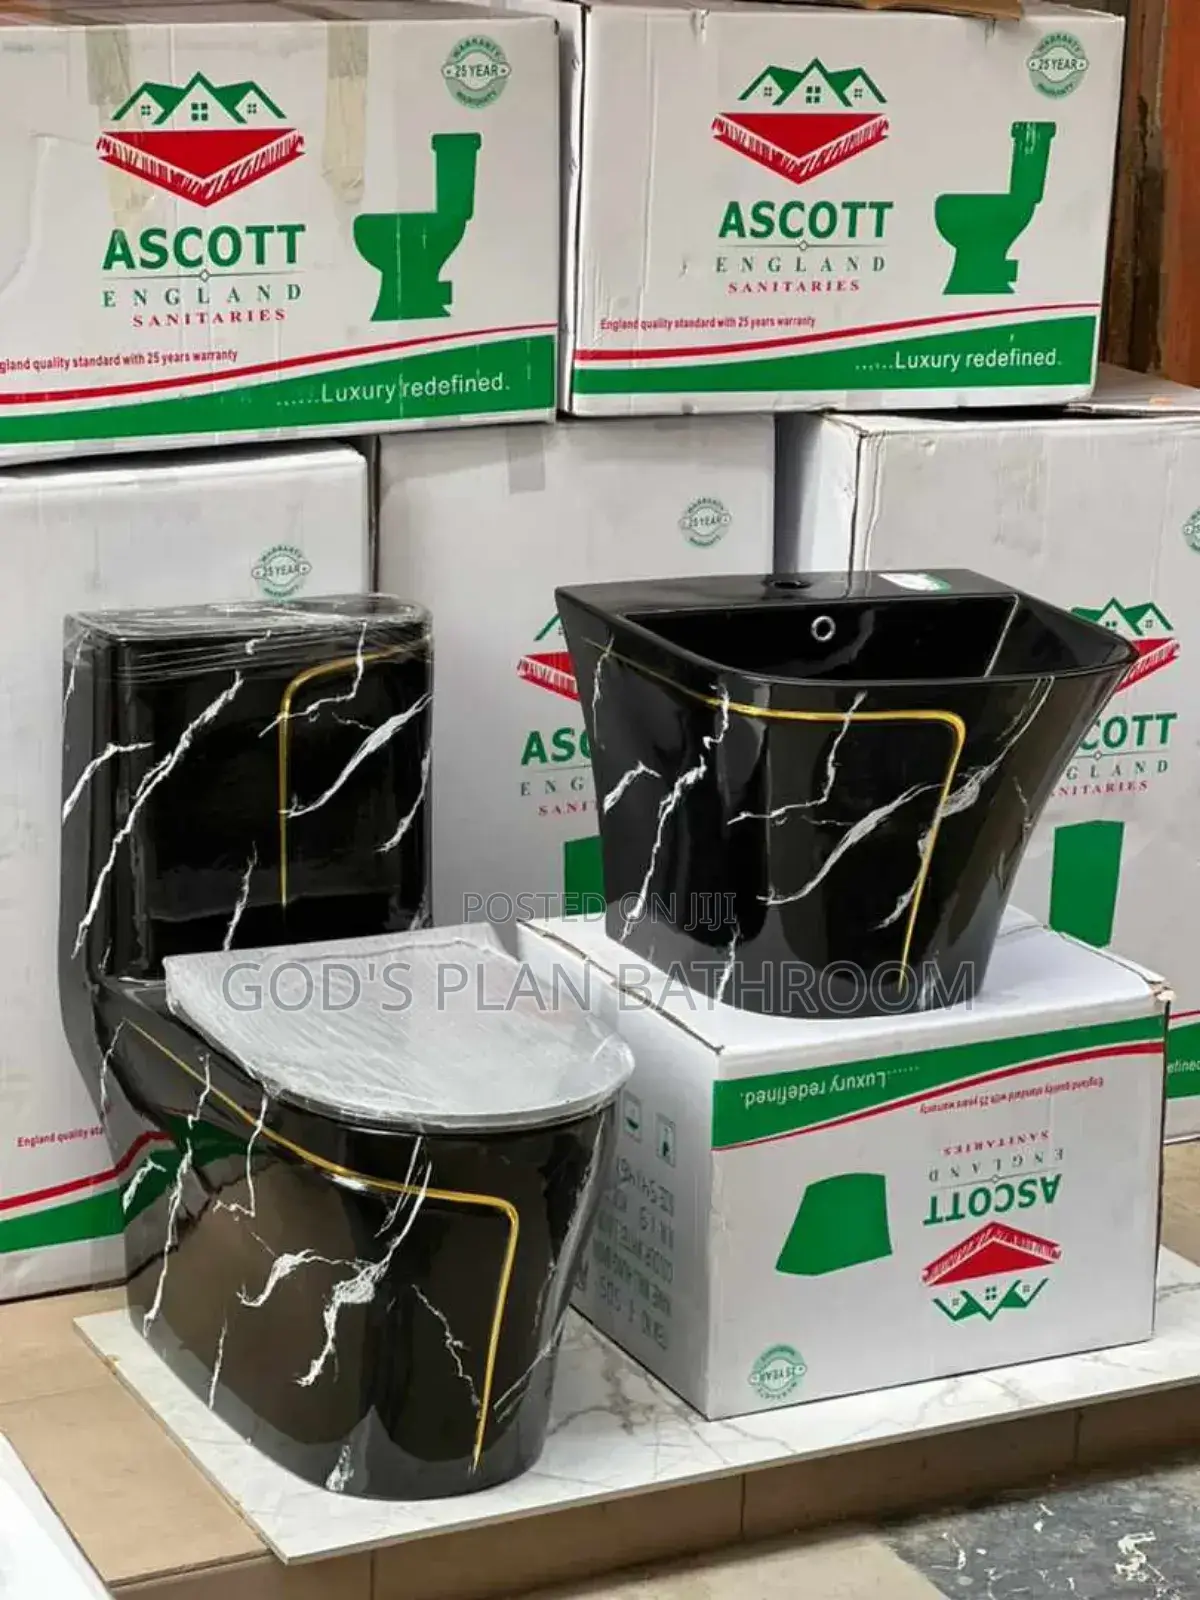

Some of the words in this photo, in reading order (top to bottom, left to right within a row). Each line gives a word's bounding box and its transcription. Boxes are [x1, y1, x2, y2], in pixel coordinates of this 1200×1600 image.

[455, 65, 466, 77] 25
[468, 64, 499, 77] YEAR
[1039, 59, 1050, 70] 25
[1051, 58, 1077, 70] YEAR
[718, 200, 894, 239] ASCOTT
[102, 224, 305, 270] ASCOTT
[716, 256, 885, 272] ENGLAND
[103, 284, 301, 308] ENGLAND
[728, 279, 860, 294] SANITARIES
[132, 309, 286, 327] SANITARIES
[600, 318, 639, 332] England
[641, 318, 672, 331] quality
[675, 316, 715, 329] standard
[718, 316, 736, 328] with
[738, 315, 749, 328] 25
[751, 316, 775, 330] years
[778, 315, 815, 329] warranty
[0, 355, 31, 374] gland
[33, 355, 70, 373] quality
[73, 353, 120, 369] standard
[122, 354, 145, 366] with
[147, 351, 160, 364] 25
[162, 350, 190, 365] years
[193, 349, 237, 363] warranty
[966, 347, 1062, 368] redefined.
[402, 371, 511, 398] redefined.
[1066, 759, 1168, 781] GLAND
[1056, 780, 1148, 798] NITARIES
[740, 1080, 826, 1111] redefined.
[17, 1132, 56, 1148] England
[57, 1128, 89, 1144] quality
[942, 1129, 1050, 1157] SANITARIES
[929, 1148, 1064, 1182] ENGLAND
[923, 1173, 1062, 1226] ASCOTT
